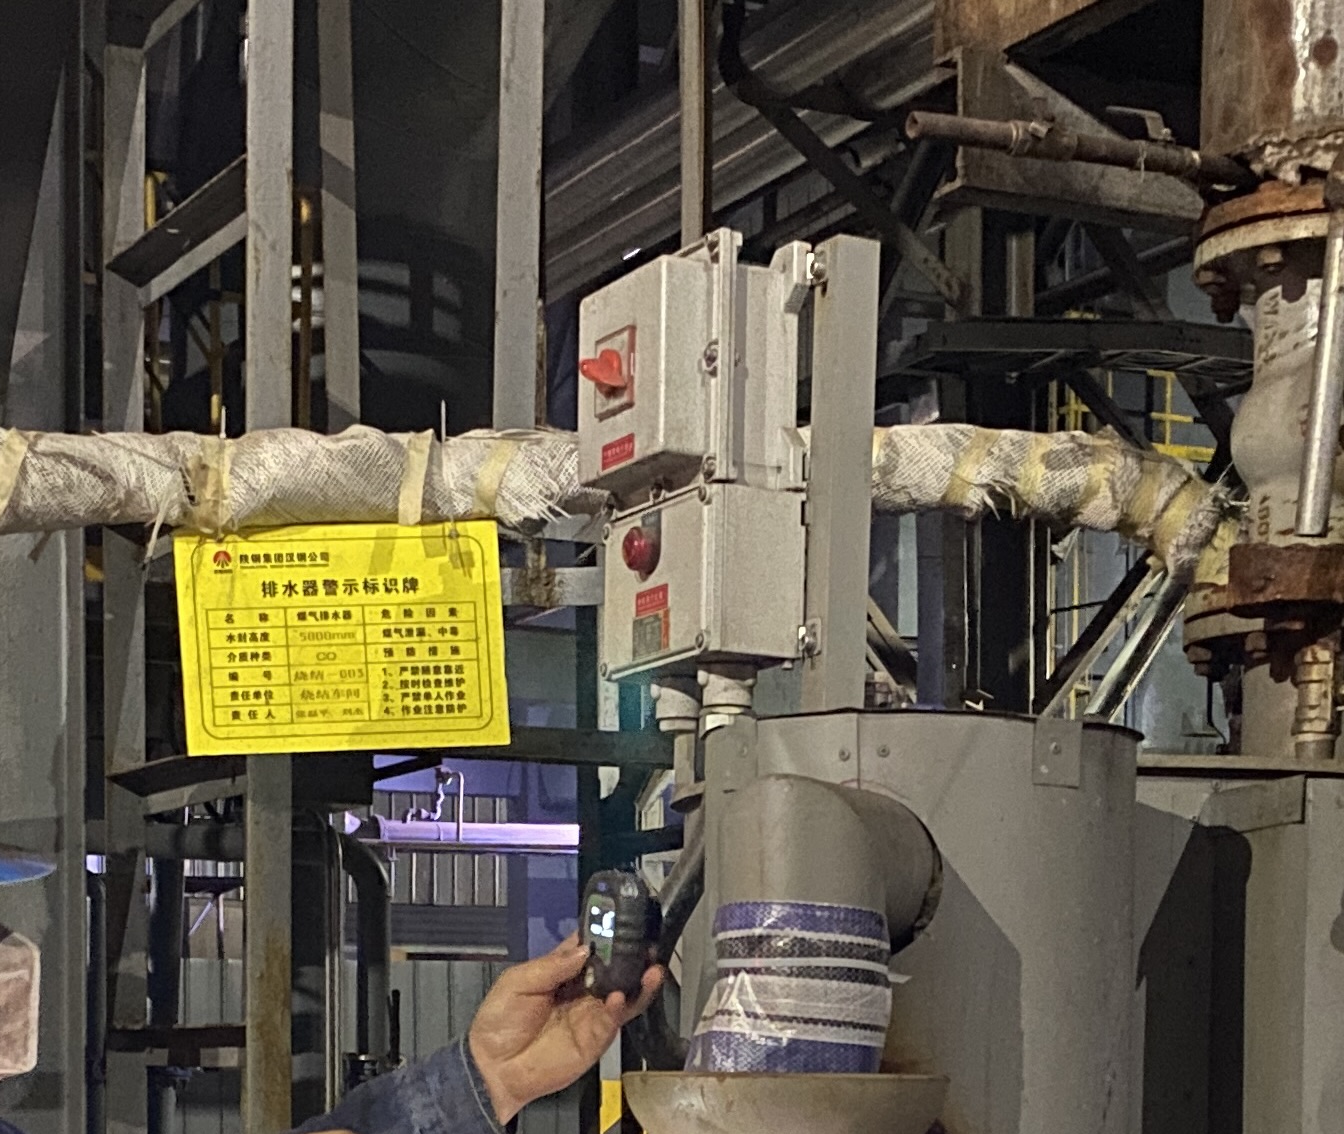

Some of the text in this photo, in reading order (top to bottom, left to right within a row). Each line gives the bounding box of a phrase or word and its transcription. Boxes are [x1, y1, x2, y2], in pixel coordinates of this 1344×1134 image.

[262, 577, 420, 598] 排水器警示标识牌
[226, 632, 270, 643] 水封高度
[227, 651, 272, 663] 介质种类
[316, 651, 337, 661] CO
[231, 708, 276, 721] 责任人
